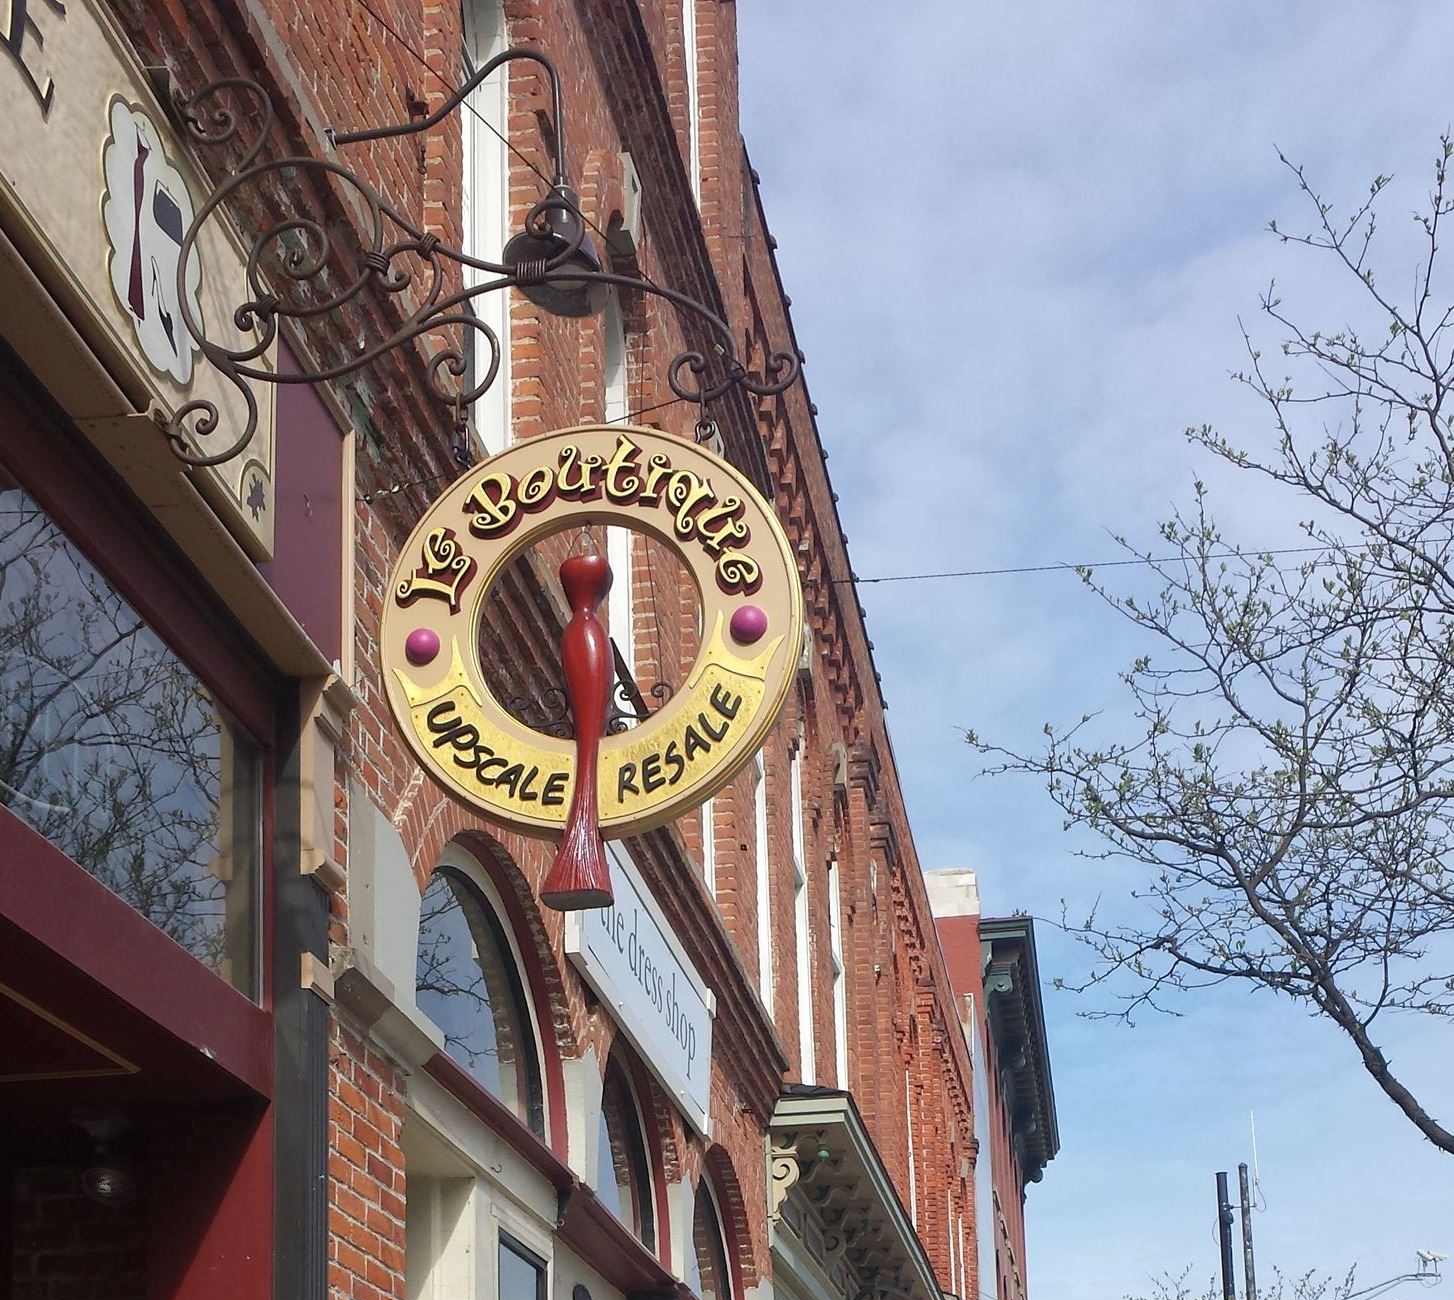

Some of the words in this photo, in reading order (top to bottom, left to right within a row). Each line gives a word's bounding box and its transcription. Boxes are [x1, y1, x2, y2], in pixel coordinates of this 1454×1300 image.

[395, 526, 475, 613] Le
[462, 434, 764, 597] Boutique
[426, 700, 570, 806] UPSCALE
[616, 683, 743, 803] RESALE
[628, 908, 663, 1014] dress
[665, 972, 696, 1080] shop
